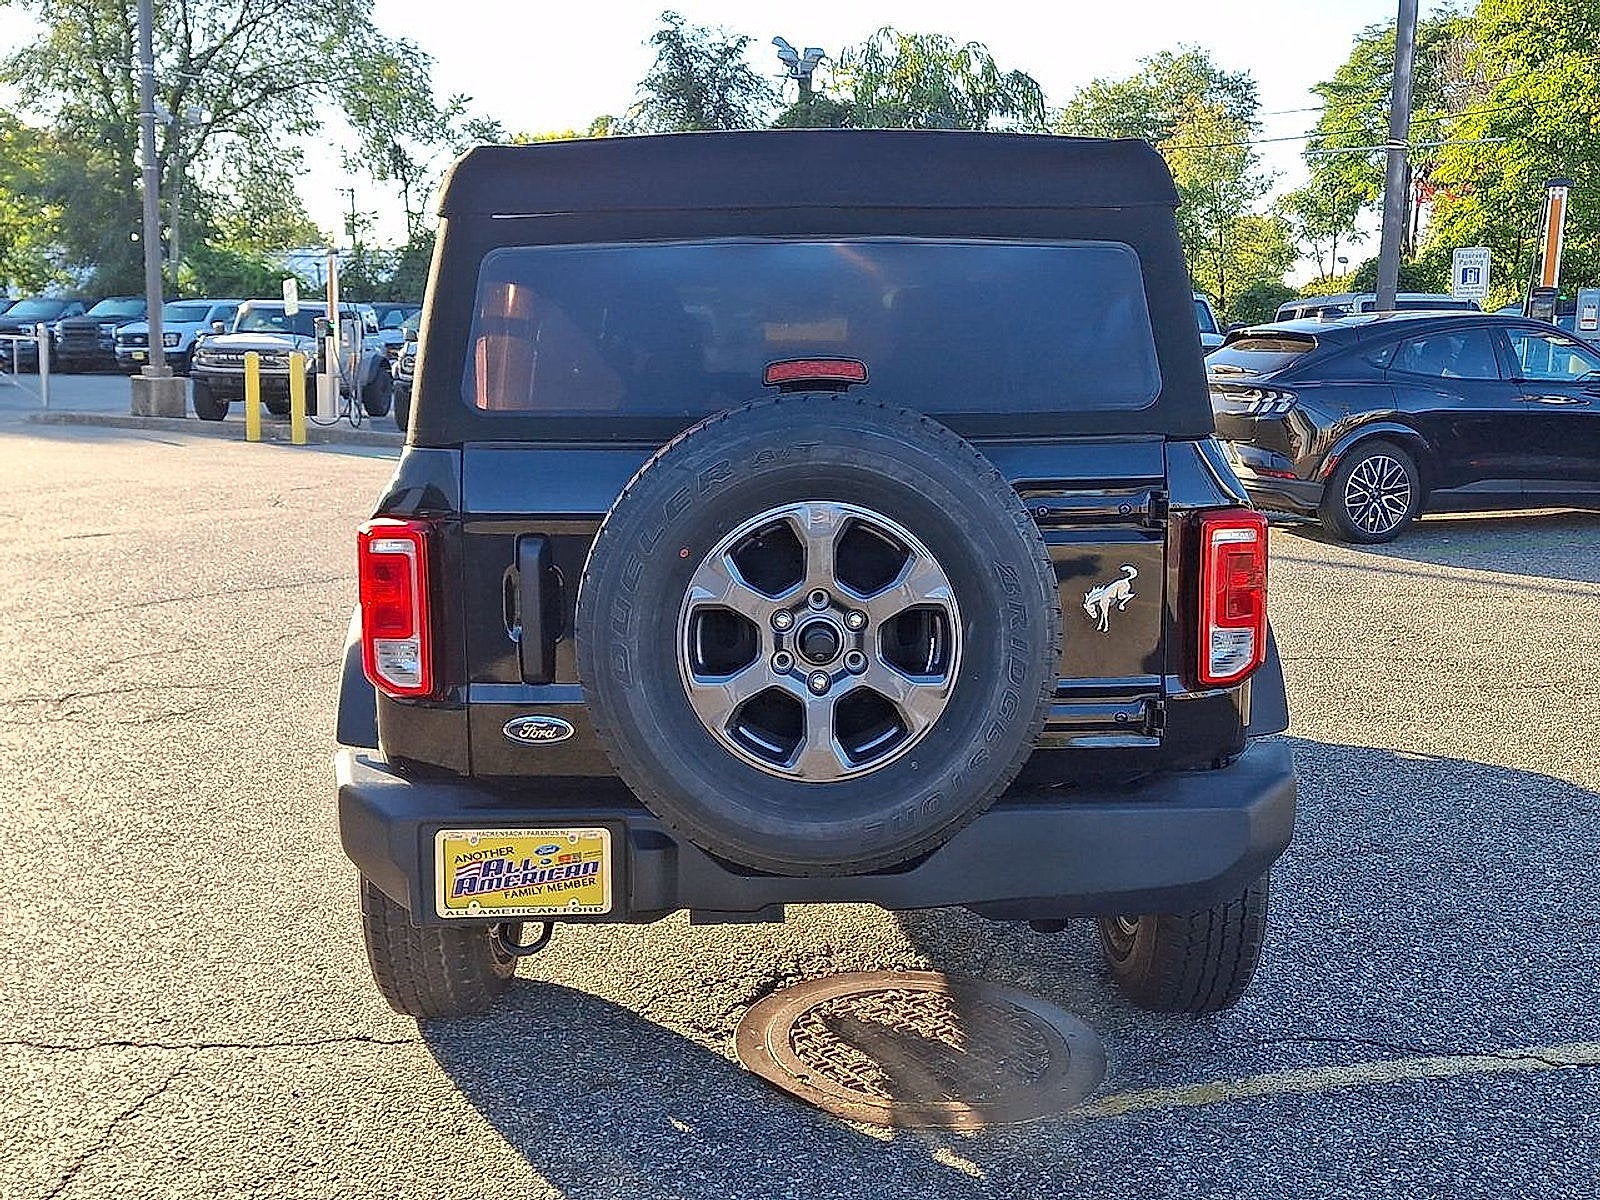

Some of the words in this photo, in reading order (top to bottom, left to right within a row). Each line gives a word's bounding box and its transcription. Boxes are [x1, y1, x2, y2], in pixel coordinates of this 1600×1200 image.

[609, 458, 736, 691] DUELER
[518, 721, 558, 739] Ford
[454, 846, 515, 864] ANOTHER
[503, 885, 544, 900] FAMILY
[547, 877, 597, 894] MEMBER
[478, 907, 558, 916] AMERICAN
[561, 906, 604, 914] FORD
